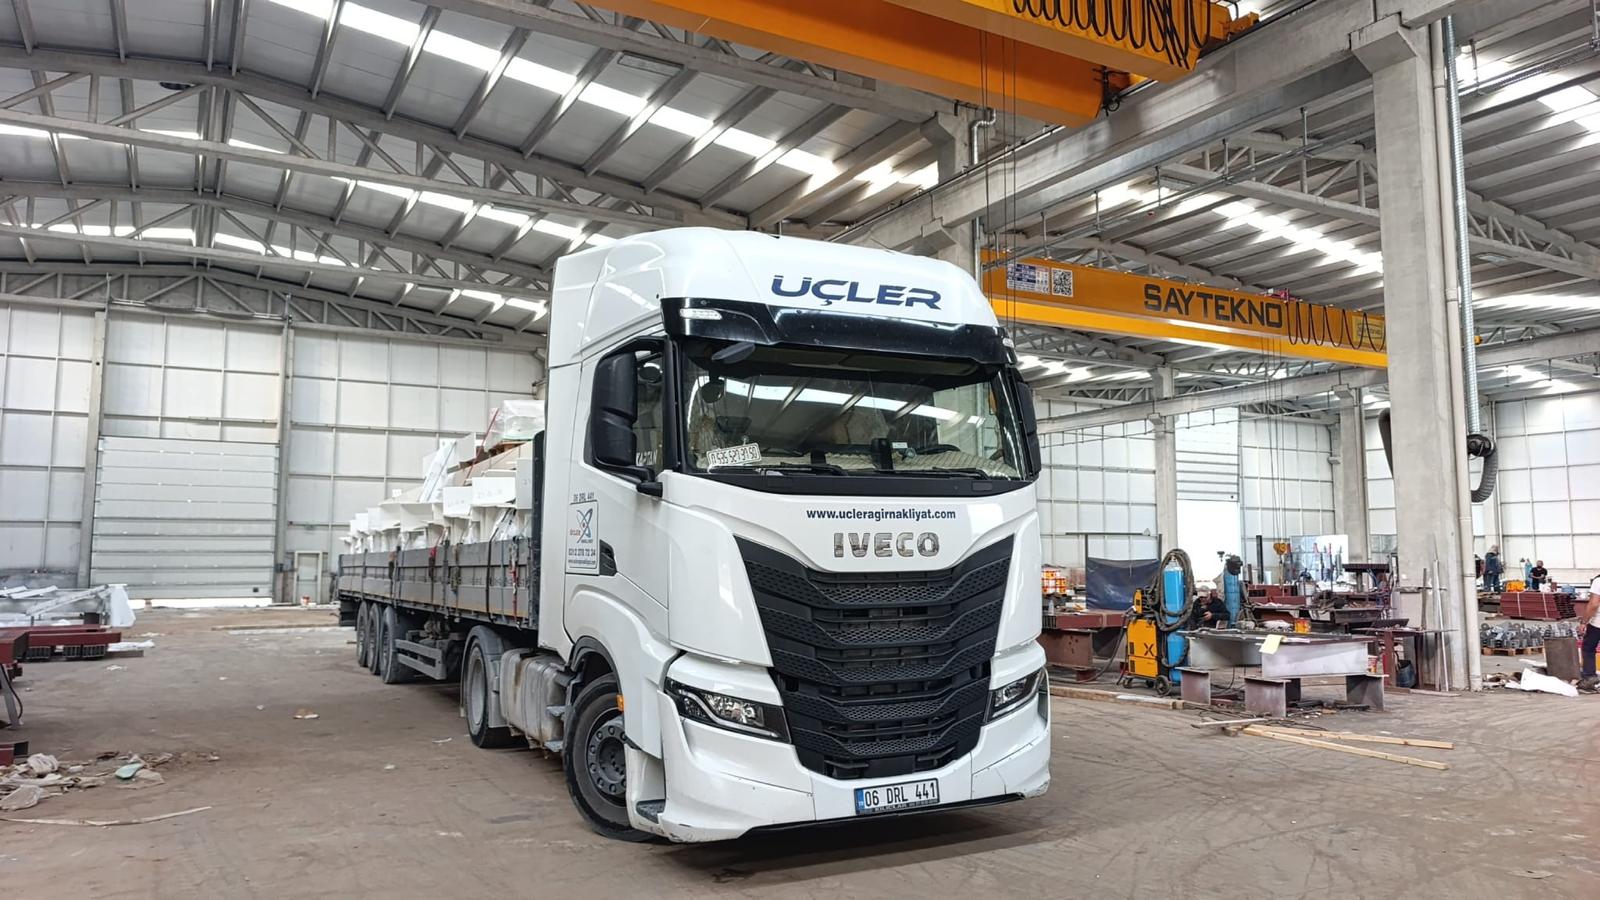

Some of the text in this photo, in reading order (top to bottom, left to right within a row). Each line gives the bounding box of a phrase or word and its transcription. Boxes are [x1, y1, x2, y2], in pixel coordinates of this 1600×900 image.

[771, 275, 941, 310] ÜÇLER
[1144, 283, 1282, 328] SAYTEKNO
[806, 507, 956, 521] www.ucleragirnakliyat.com
[834, 532, 940, 557] IVECO
[865, 790, 879, 807] 06
[886, 786, 909, 804] DRL
[915, 782, 936, 800] 441
